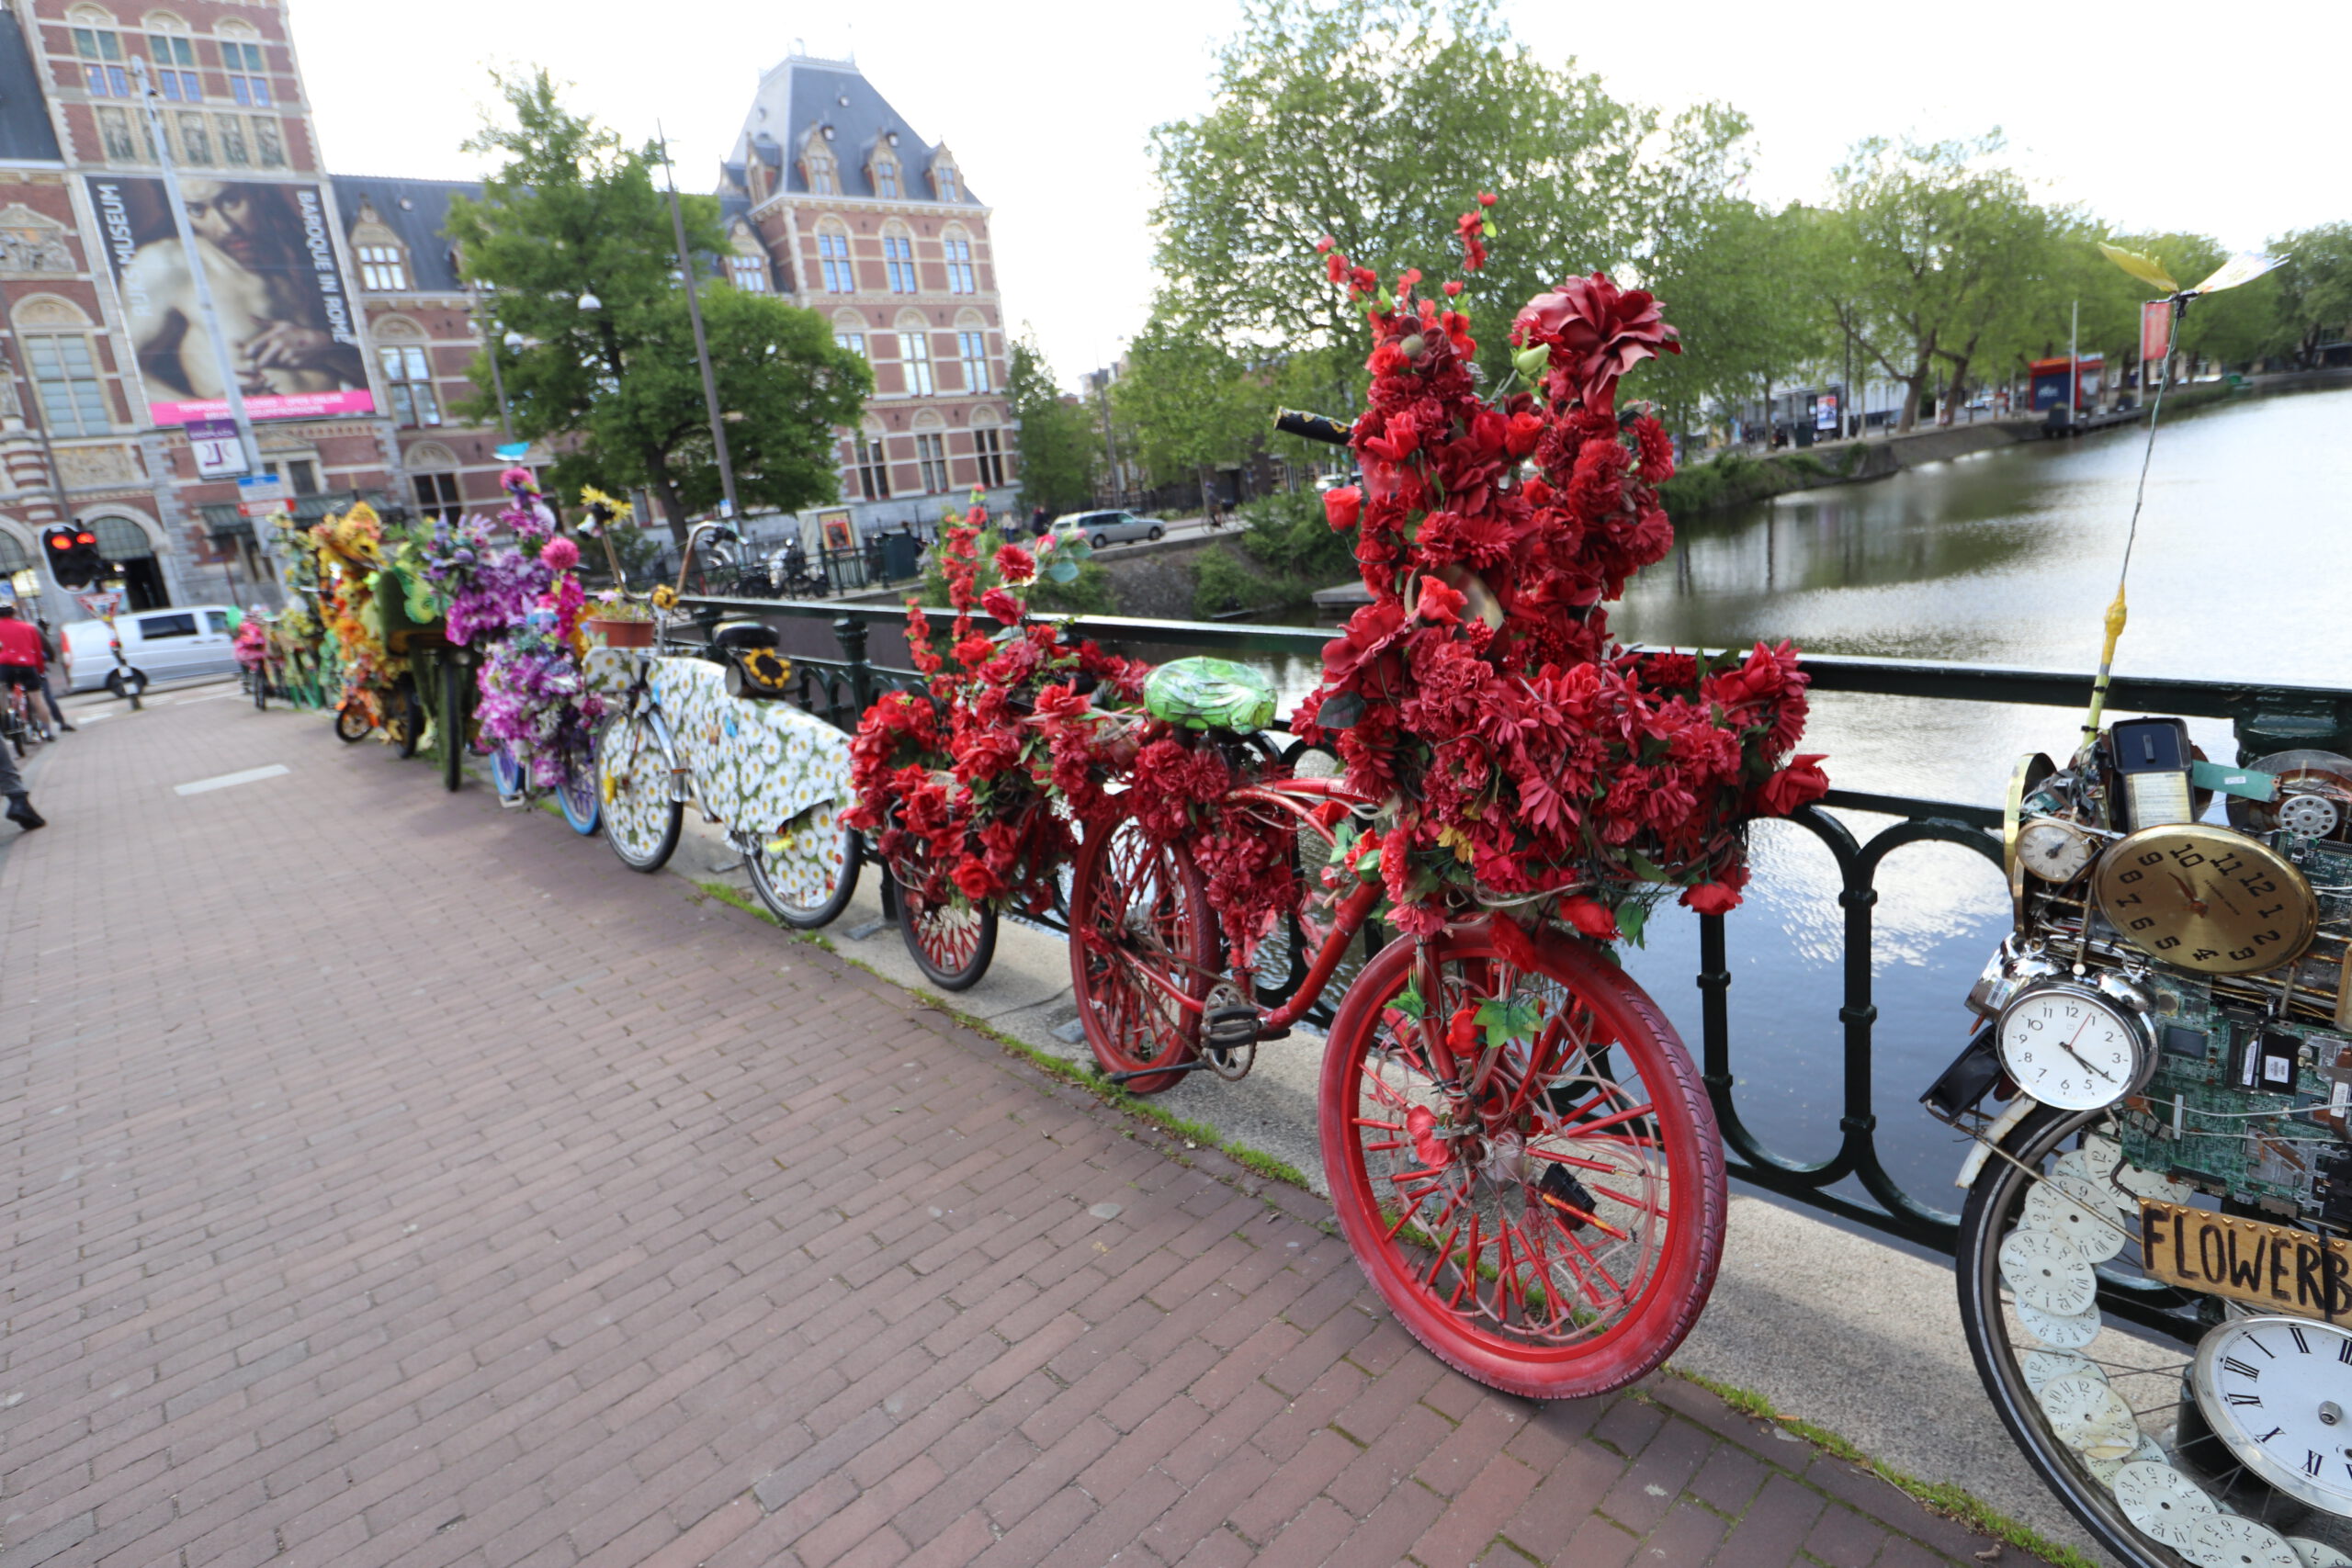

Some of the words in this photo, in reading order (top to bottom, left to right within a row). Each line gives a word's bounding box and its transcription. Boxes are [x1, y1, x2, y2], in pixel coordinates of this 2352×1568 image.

[296, 190, 333, 271] BAROQUE
[319, 273, 340, 292] IN
[323, 296, 352, 344] ROME
[2138, 852, 2163, 867] 9
[2169, 843, 2205, 868] 10
[2211, 852, 2243, 876] 11
[2119, 870, 2143, 884] 8
[2240, 873, 2276, 897] 12
[2116, 893, 2142, 908] 7
[2258, 904, 2283, 919] 1
[2130, 917, 2155, 931] 6
[2154, 936, 2181, 950] 5
[2253, 931, 2280, 945] 2
[2192, 948, 2220, 961] 4
[2230, 946, 2256, 961] 3
[2043, 1007, 2053, 1019] 11
[2065, 1006, 2079, 1018] 12
[2027, 1019, 2043, 1031] 10
[2091, 1015, 2096, 1026] 1
[2018, 1034, 2028, 1043] 9
[2105, 1031, 2114, 1043] 2
[2024, 1052, 2032, 1063] 8
[2111, 1053, 2121, 1064] 3
[2038, 1067, 2047, 1078] 7
[2061, 1079, 2070, 1089] 6
[2084, 1079, 2093, 1089] 5
[2246, 1335, 2276, 1359] I
[2289, 1327, 2312, 1354] II
[2223, 1356, 2260, 1383] XII
[2227, 1393, 2264, 1409] XI
[2256, 1427, 2287, 1444] X
